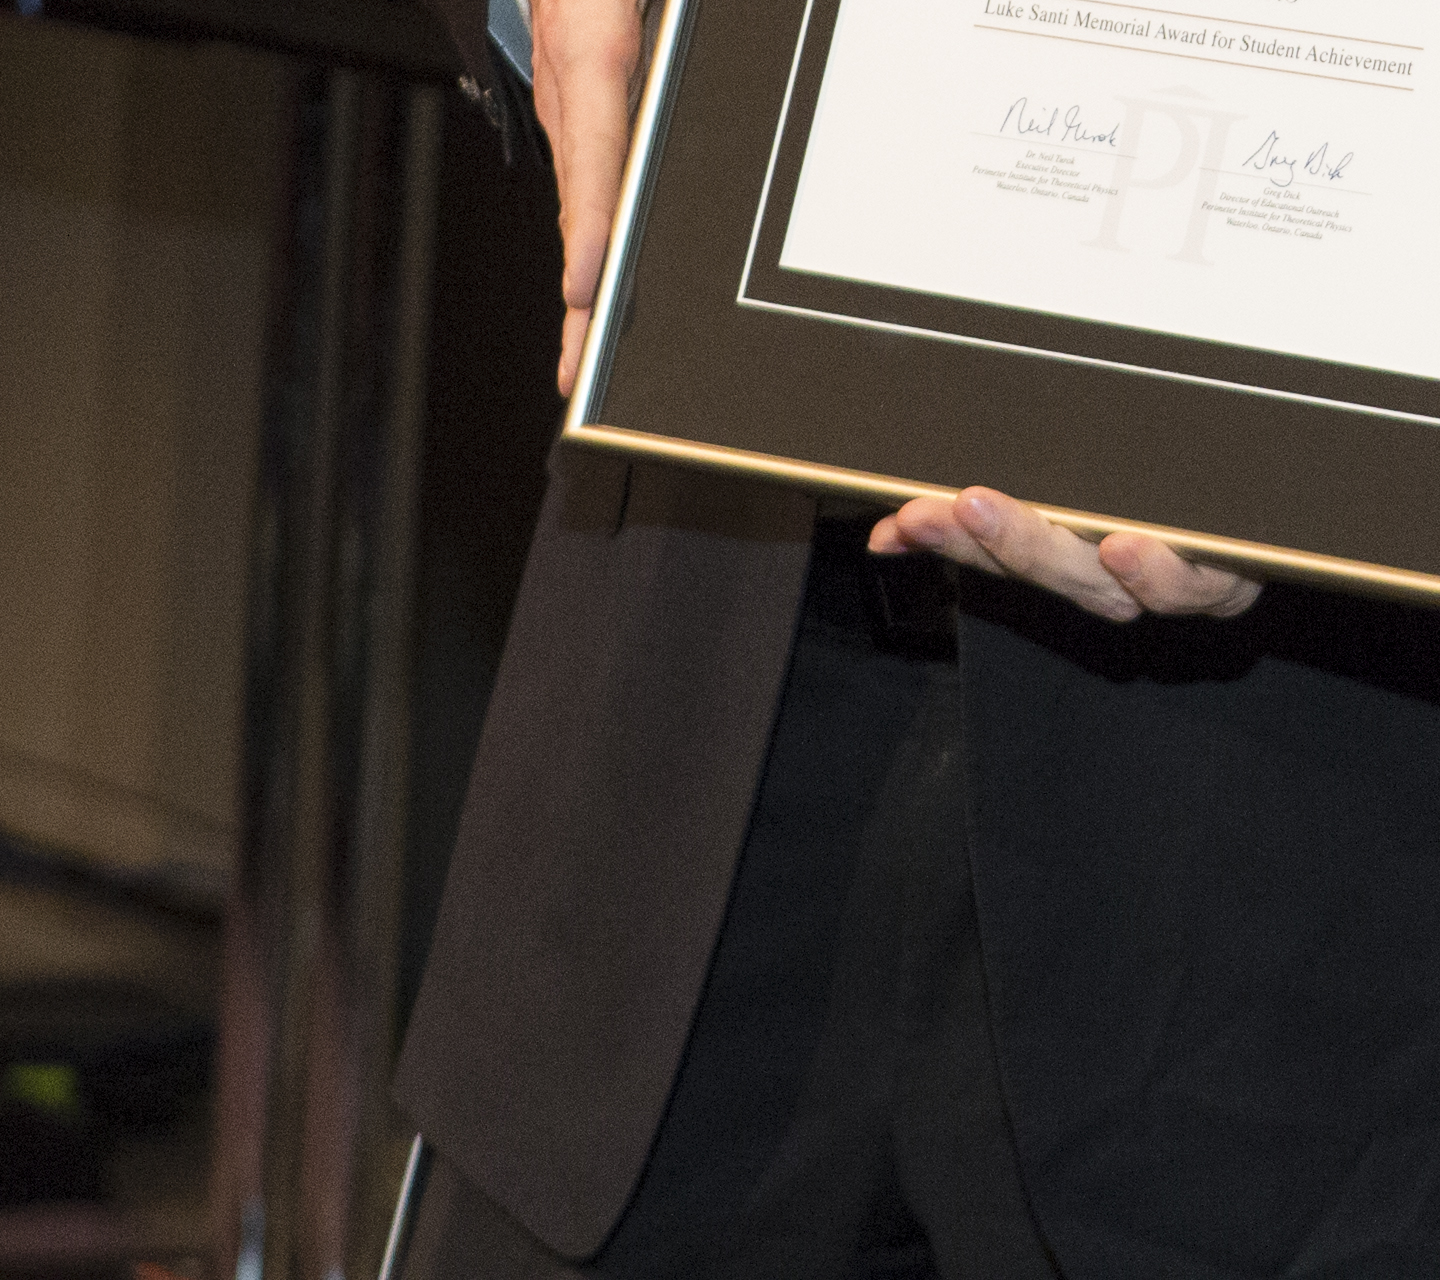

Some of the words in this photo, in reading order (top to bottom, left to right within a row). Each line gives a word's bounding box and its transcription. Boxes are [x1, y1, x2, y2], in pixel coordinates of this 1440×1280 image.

[1028, 3, 1068, 26] Santi
[1073, 11, 1150, 38] Memorial
[1154, 22, 1206, 47] Award
[1211, 30, 1236, 50] for
[1240, 35, 1301, 60] Student
[1305, 45, 1413, 76] Achievement
[1219, 191, 1250, 204] Director
[1263, 187, 1282, 200] Greg
[1283, 189, 1301, 200] Dick
